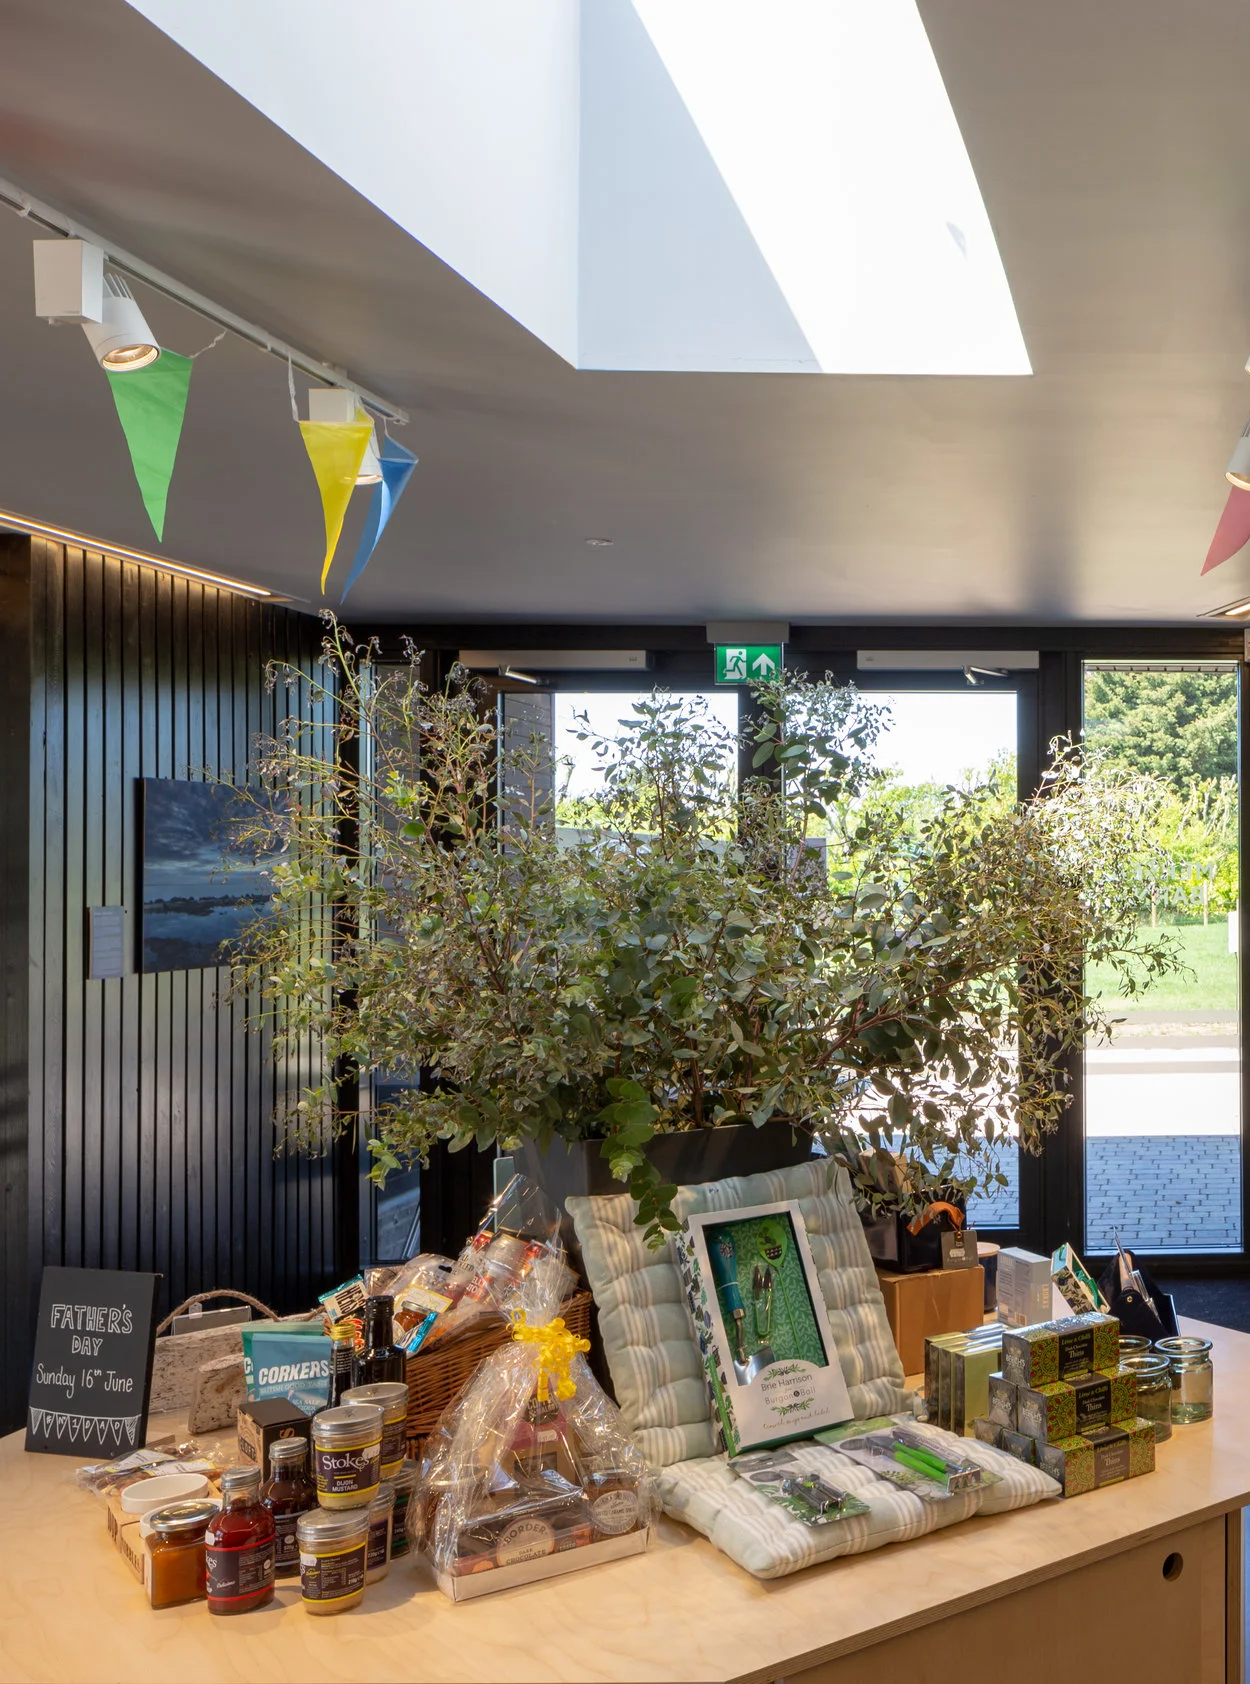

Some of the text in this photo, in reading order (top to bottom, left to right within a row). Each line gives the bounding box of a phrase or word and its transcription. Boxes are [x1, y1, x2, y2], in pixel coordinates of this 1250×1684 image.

[51, 1304, 133, 1334] FATHER'S
[71, 1335, 103, 1356] DAY
[36, 1362, 133, 1399] Sunday 16th June
[258, 1359, 330, 1386] CORKERS
[761, 1374, 813, 1392] Brie Harrison
[764, 1393, 794, 1405] Burgon
[800, 1386, 816, 1397] Ball
[322, 1452, 369, 1472] Stokes
[332, 1484, 358, 1492] MUSTARD
[503, 1522, 546, 1544] BORDER
[505, 1549, 546, 1565] CHOCOLATE
